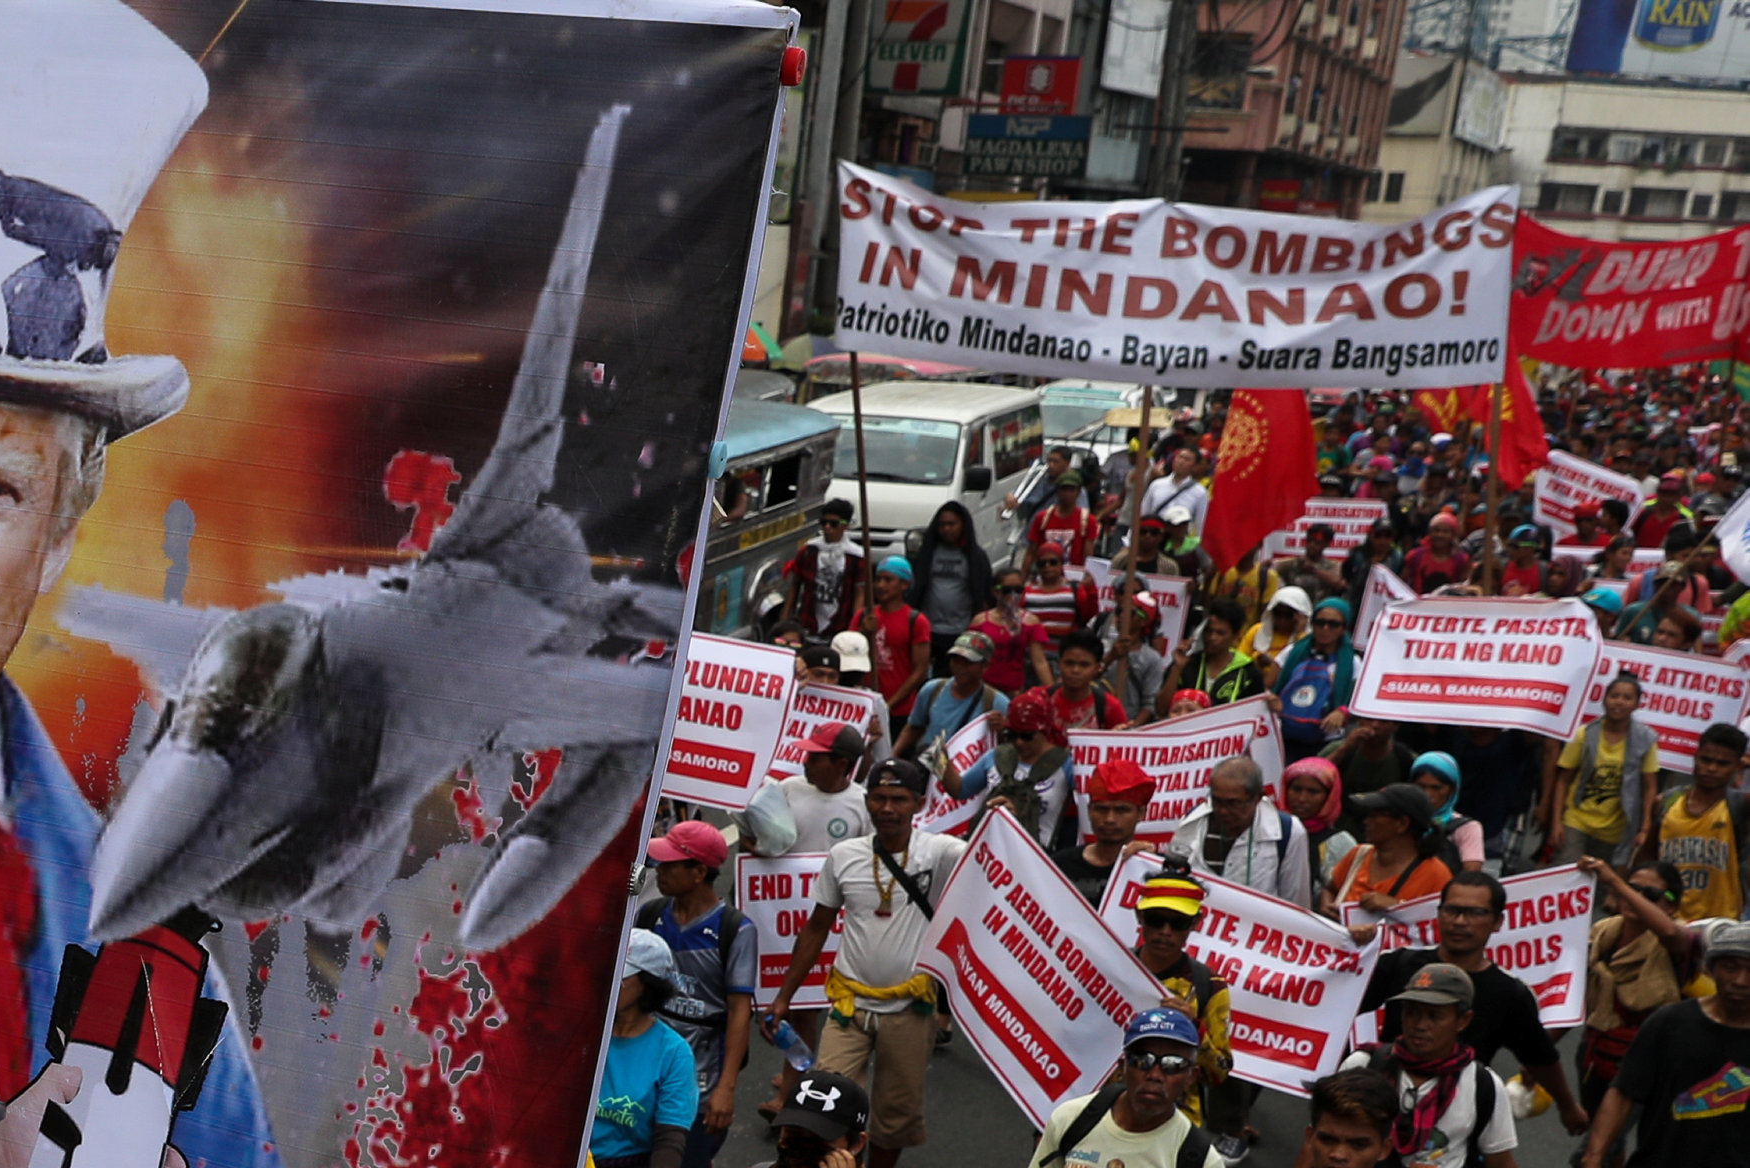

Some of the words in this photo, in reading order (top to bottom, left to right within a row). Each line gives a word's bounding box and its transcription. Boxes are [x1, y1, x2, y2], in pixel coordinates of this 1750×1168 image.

[968, 140, 1085, 158] MAGDALENA
[969, 157, 1080, 175] PAWNSHOP
[1011, 212, 1140, 256] THE
[1160, 203, 1516, 274] BOMBINGS
[859, 242, 922, 290] IN
[949, 256, 1469, 326] MINDANAO!
[1584, 242, 1720, 296] DUMP
[1532, 297, 1651, 346] DOWN
[1655, 296, 1713, 331] WITH
[959, 315, 1092, 363] Mindanao
[1120, 336, 1208, 375] Bayan
[1238, 340, 1321, 371] Suara
[1332, 337, 1499, 376] Bangsamoro
[1388, 613, 1486, 635] DUTERTE,
[1492, 617, 1592, 642] PASISTA,
[1402, 639, 1457, 660] TUTA
[1461, 642, 1493, 662] NG
[1498, 643, 1564, 666] KANO
[1445, 683, 1564, 706] BANGSAMORO
[1655, 666, 1744, 699] ATTACKS
[1106, 735, 1245, 767] MILITARISATION
[748, 873, 792, 900] END
[974, 841, 1013, 890] STOP
[1005, 882, 1060, 949] AERIAL
[982, 904, 1009, 936] IN
[1000, 924, 1085, 1021] MINDANAO
[1246, 922, 1364, 976] PASISTA,
[1243, 964, 1326, 1007] KANO
[985, 993, 1061, 1079] MINDANAO
